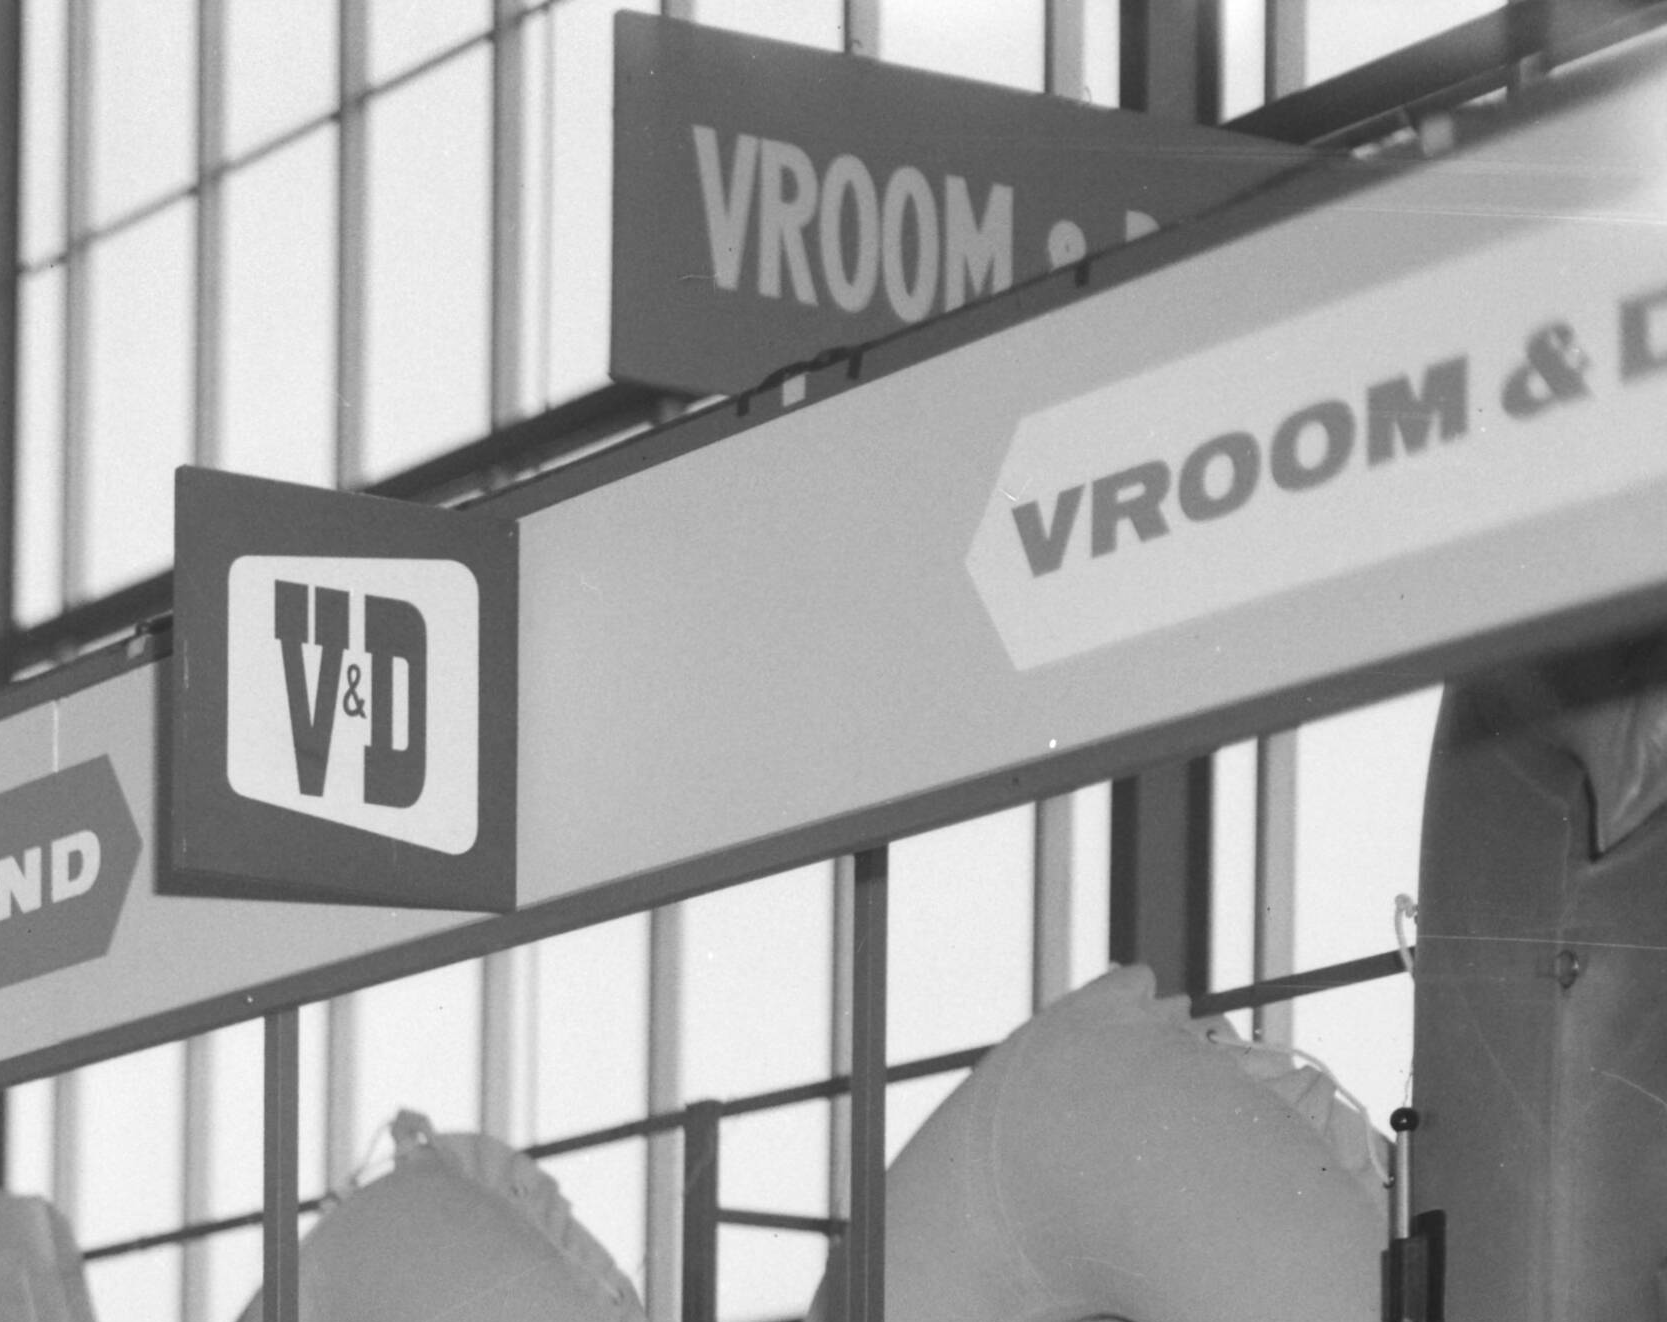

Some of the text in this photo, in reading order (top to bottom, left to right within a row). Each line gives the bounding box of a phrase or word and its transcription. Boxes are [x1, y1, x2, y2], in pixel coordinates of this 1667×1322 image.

[691, 124, 1014, 322] VROOM
[1010, 354, 1469, 579] VROOM
[1499, 319, 1597, 420] &
[273, 578, 427, 809] V&D
